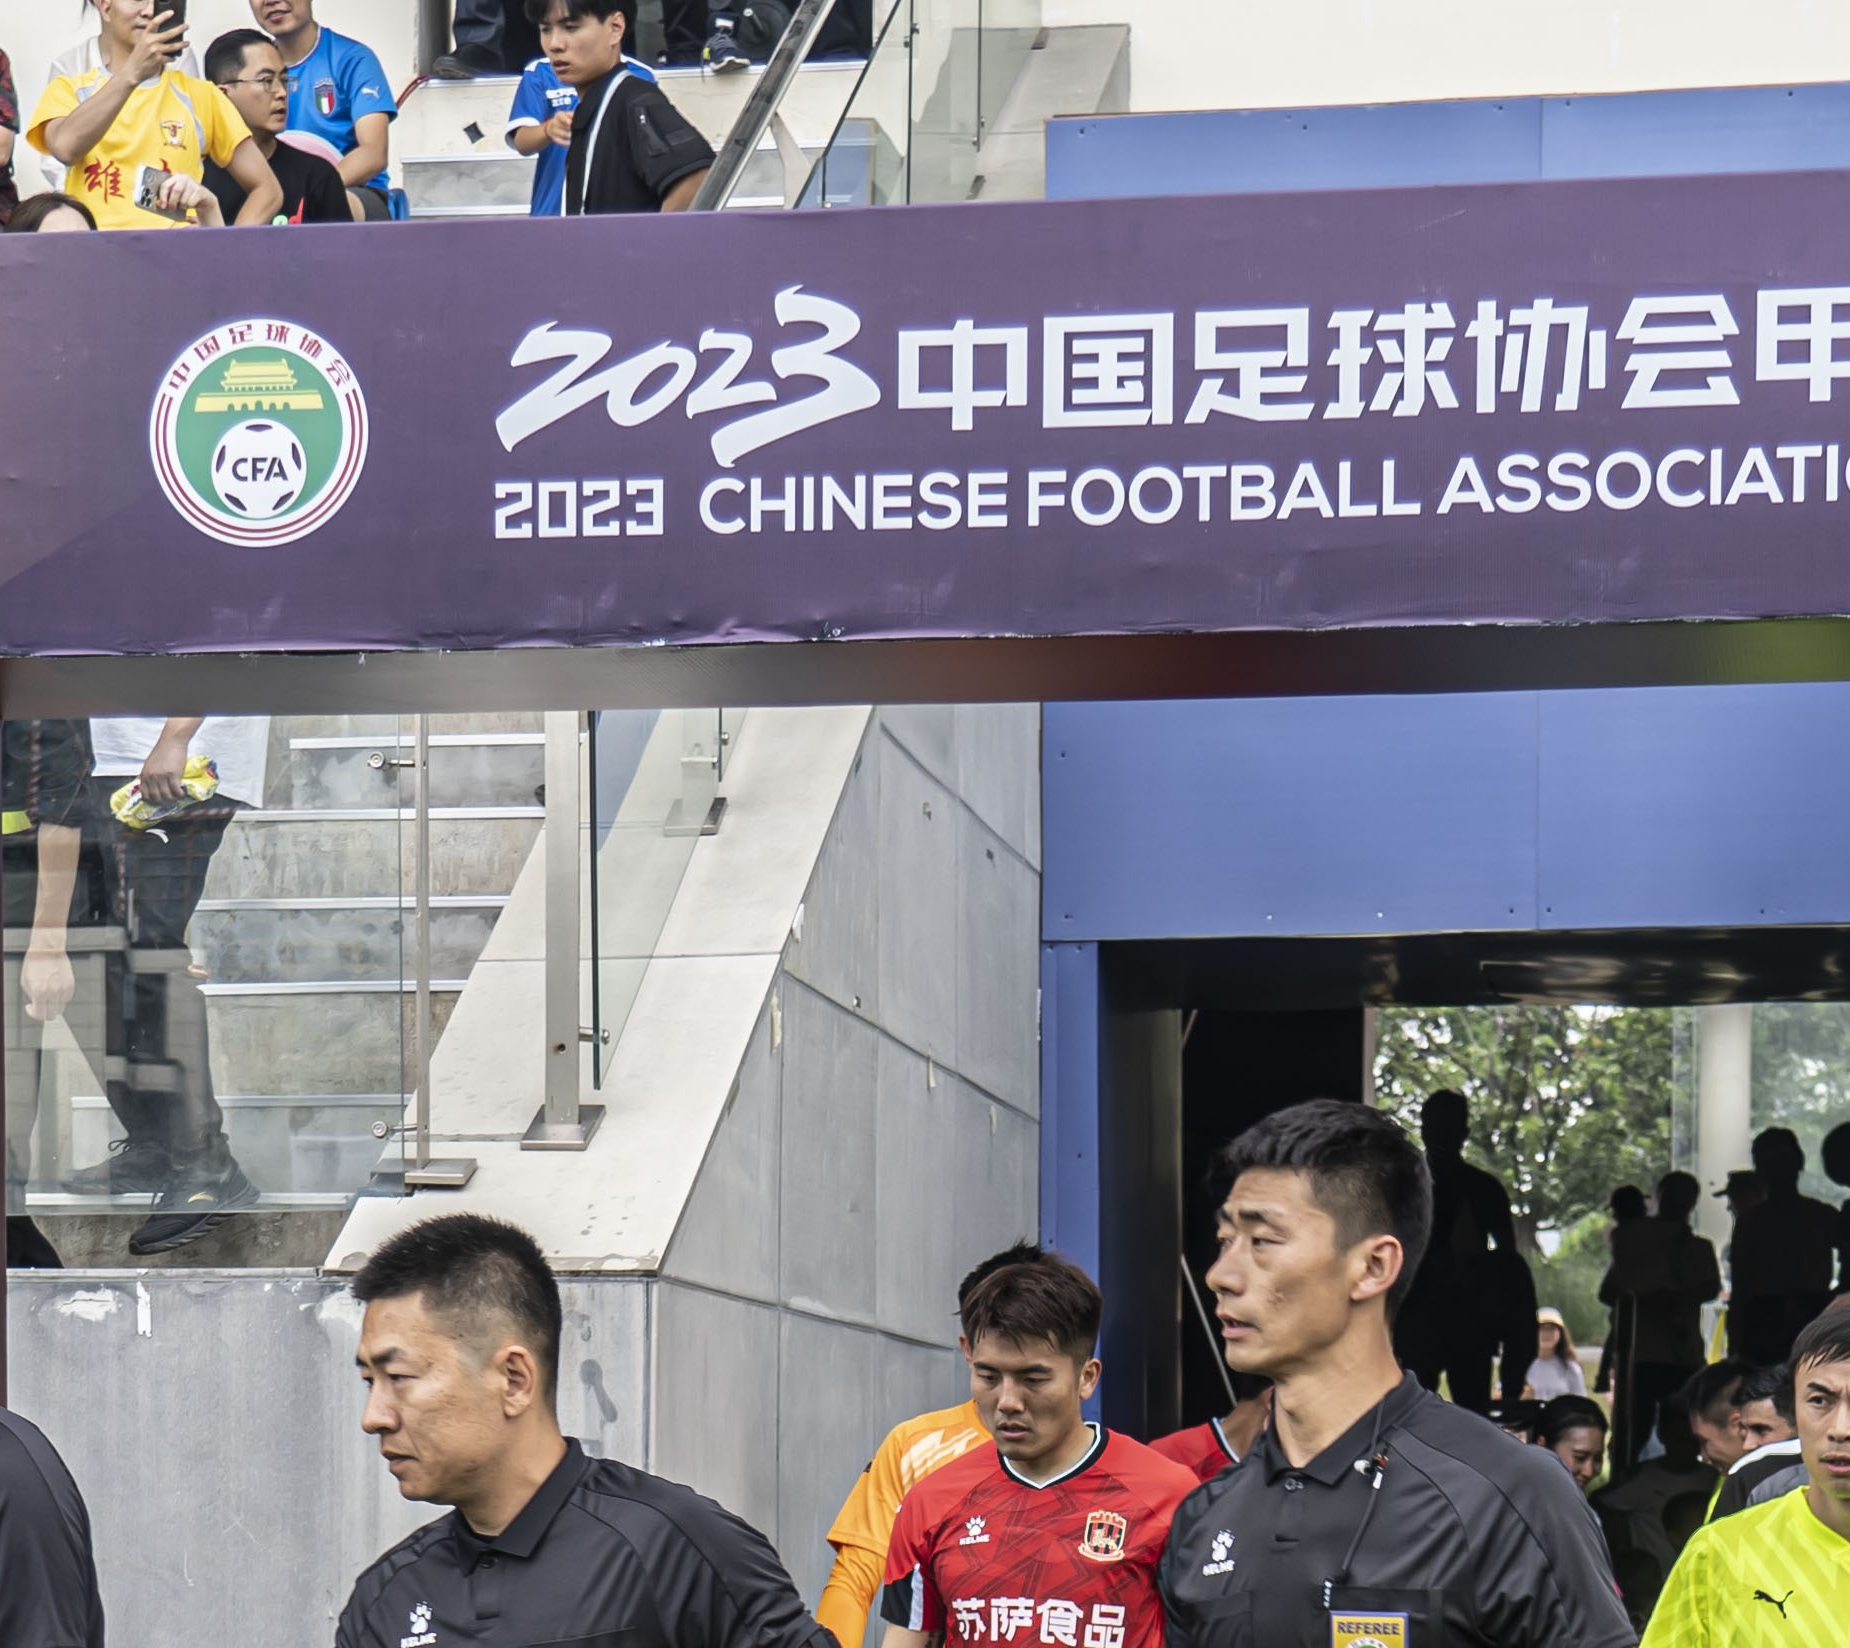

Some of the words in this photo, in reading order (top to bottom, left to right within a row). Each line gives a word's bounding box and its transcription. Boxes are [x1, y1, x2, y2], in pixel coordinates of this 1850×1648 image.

[169, 323, 351, 390] 中国足球协会
[231, 456, 289, 483] CFA
[495, 479, 664, 539] 2023
[699, 470, 1008, 535] CHINESE
[1027, 459, 1421, 527] FOOTBALL
[1337, 1621, 1401, 1636] REFEREE
